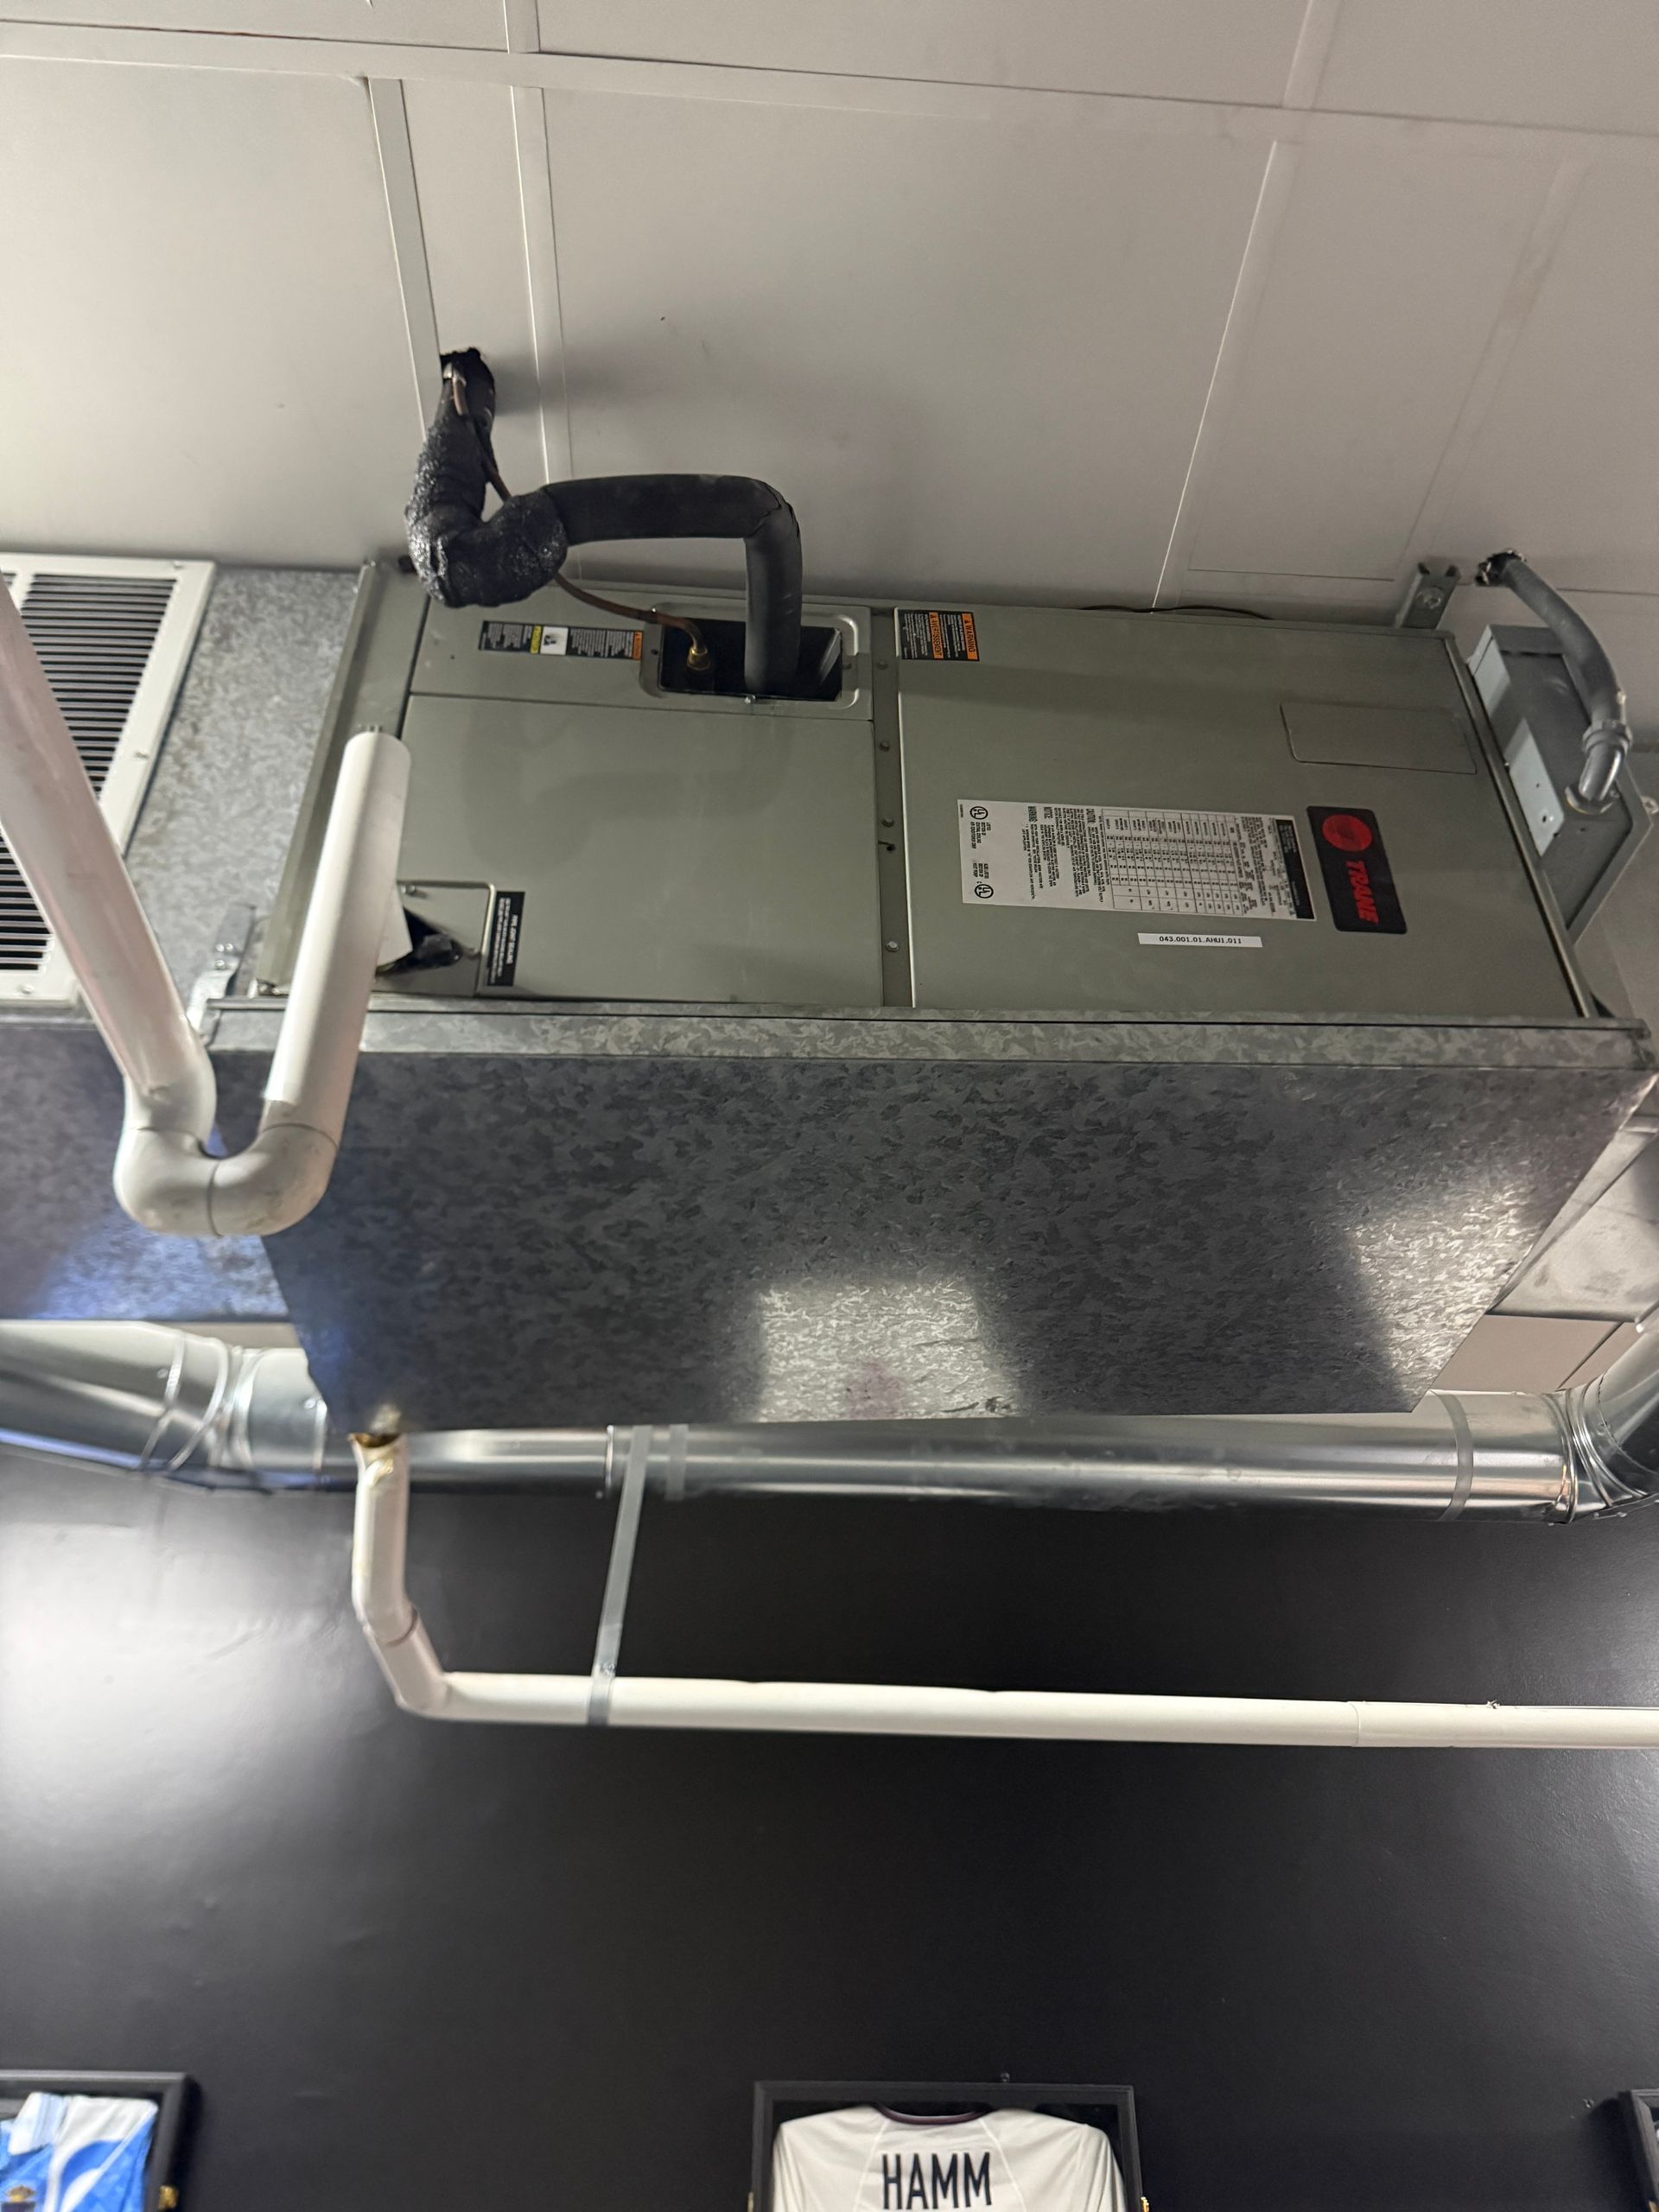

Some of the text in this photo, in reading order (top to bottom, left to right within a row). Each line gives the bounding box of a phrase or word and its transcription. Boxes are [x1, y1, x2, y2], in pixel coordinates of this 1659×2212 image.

[964, 624, 976, 652] WARNING
[1345, 861, 1379, 924] TRANE
[1159, 936, 1242, 944] 043.001.01.AHU1.011
[882, 2152, 991, 2211] HAMM
